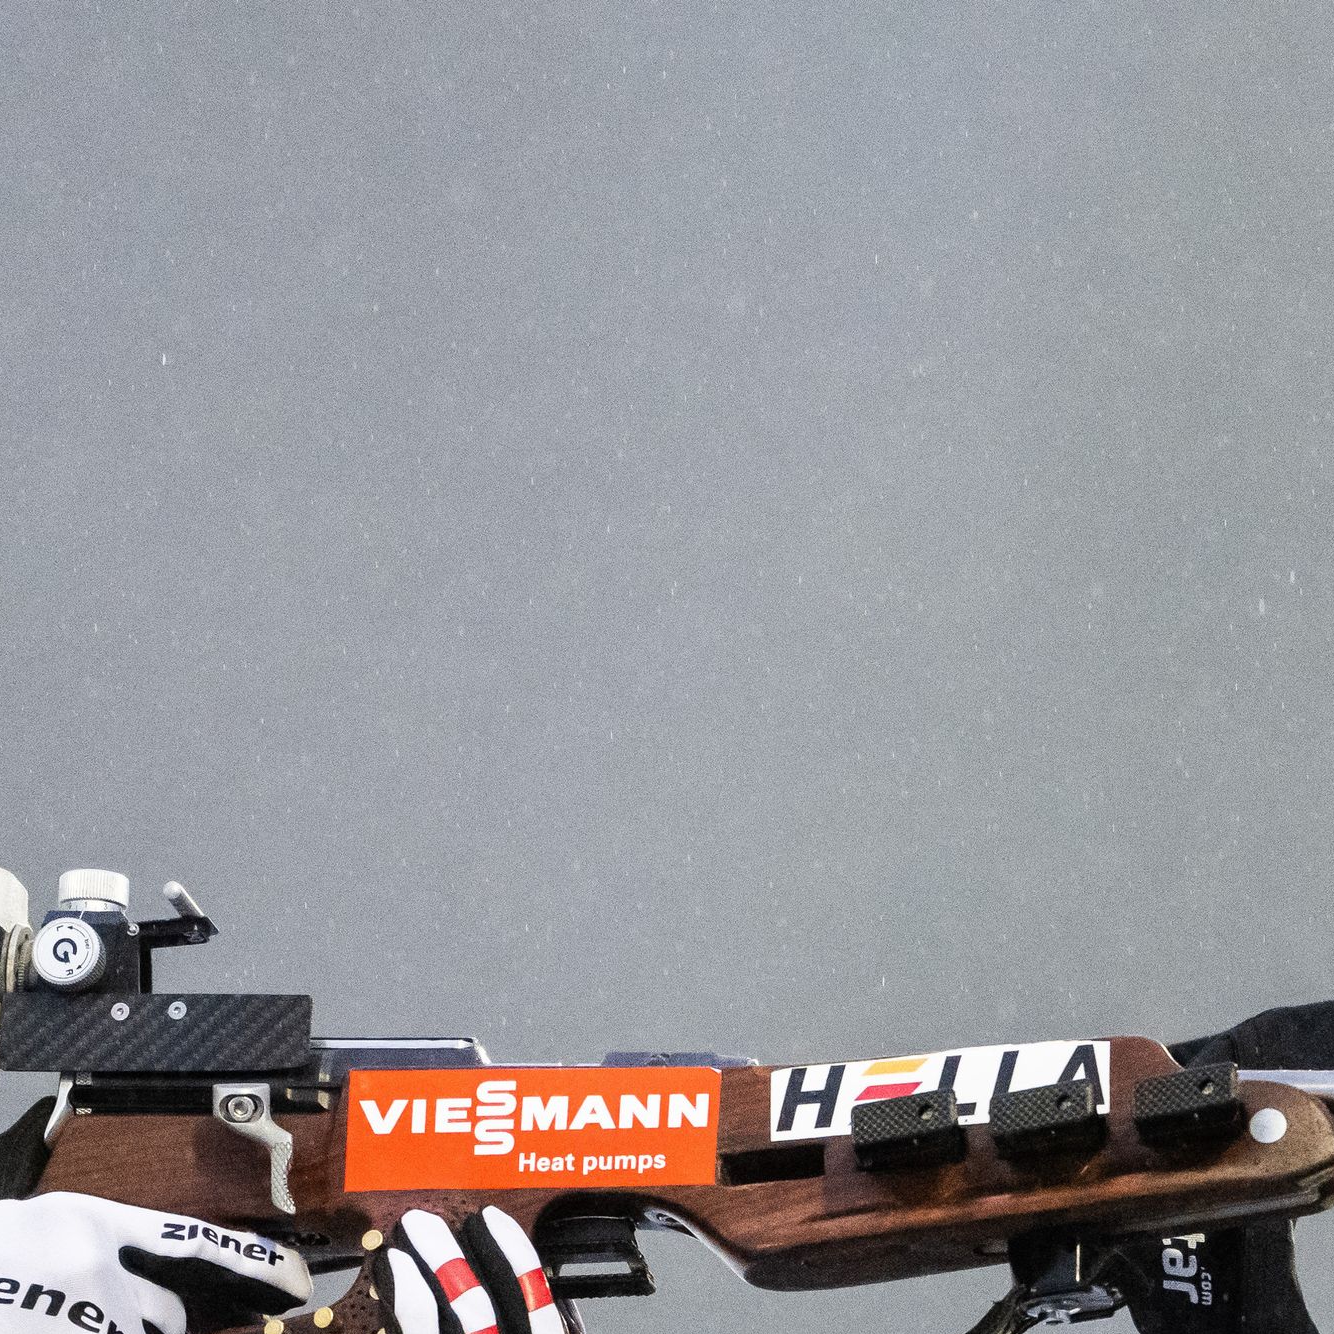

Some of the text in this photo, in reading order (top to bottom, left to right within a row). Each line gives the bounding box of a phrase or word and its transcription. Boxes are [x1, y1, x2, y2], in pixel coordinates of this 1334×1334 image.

[359, 1080, 710, 1156] VIESSMANN
[518, 1151, 667, 1175] Heat pumps
